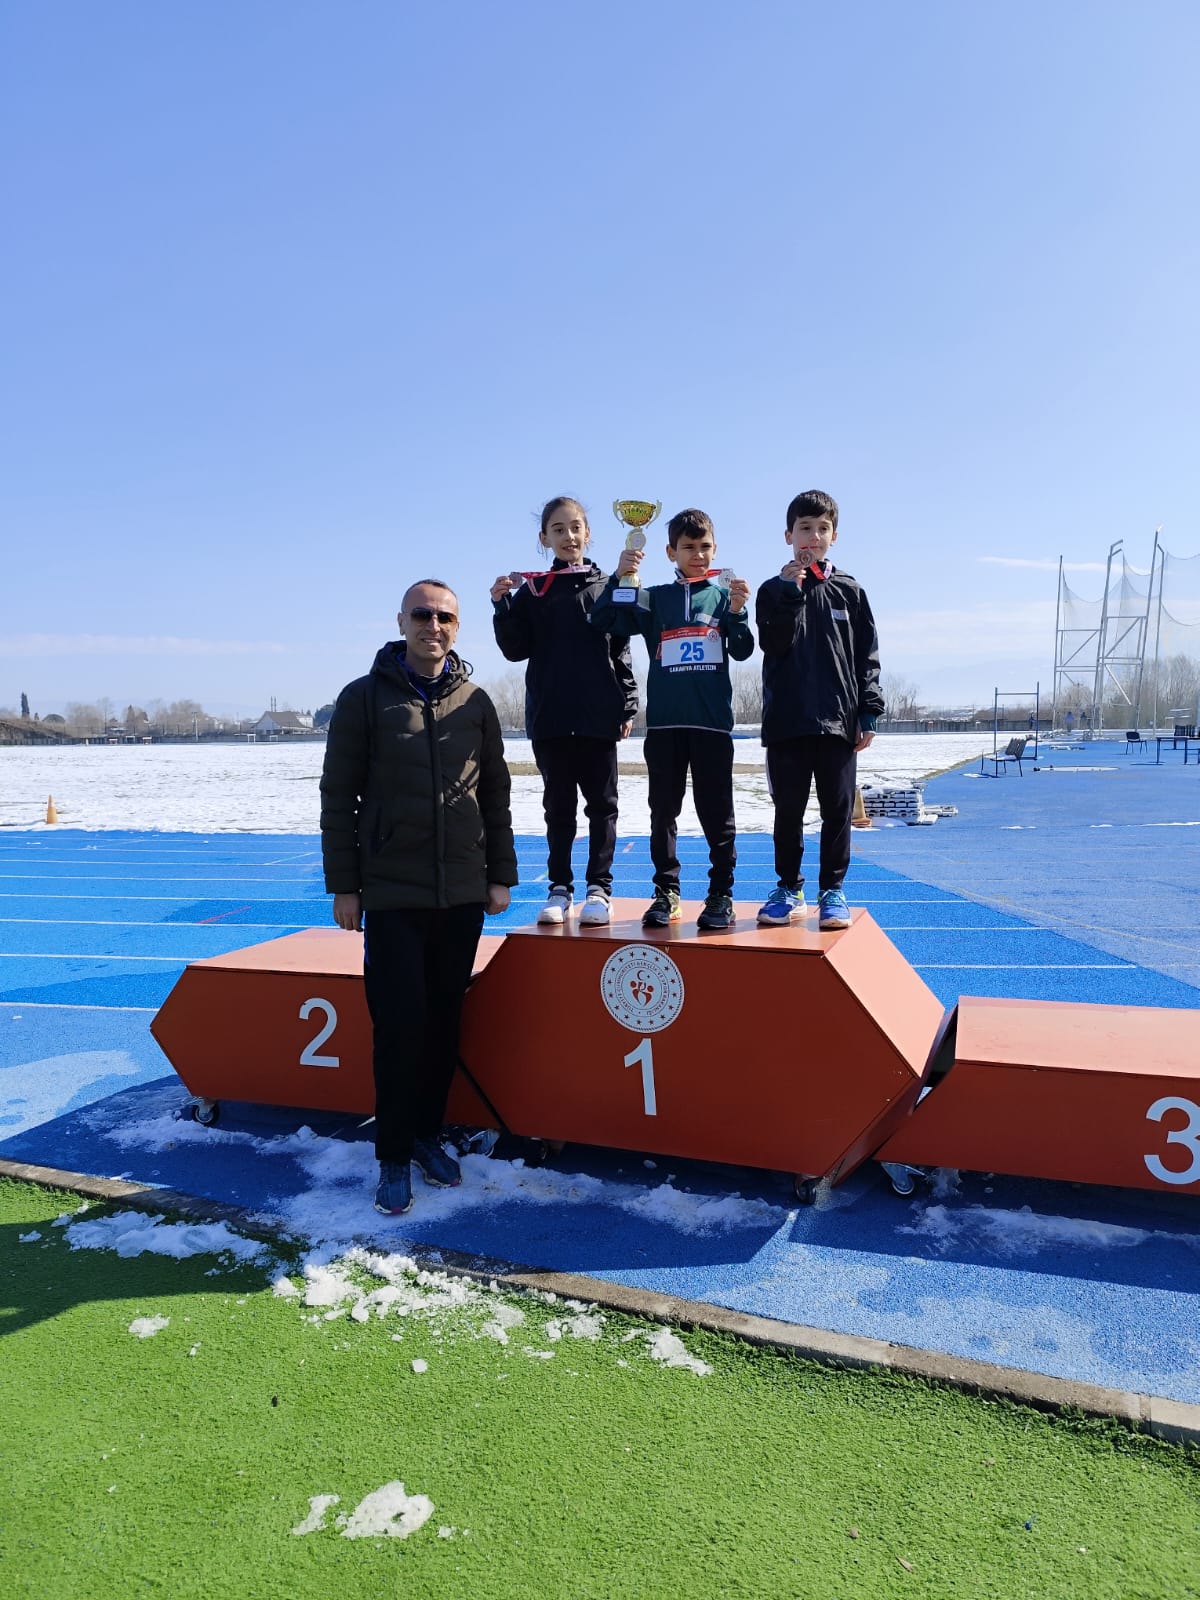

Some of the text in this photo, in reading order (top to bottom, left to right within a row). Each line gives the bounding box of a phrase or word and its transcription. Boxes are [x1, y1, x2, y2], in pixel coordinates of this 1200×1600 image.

[680, 641, 704, 662] 25
[299, 997, 339, 1068] 2
[624, 1037, 657, 1116] 1
[1143, 1096, 1200, 1184] 3
